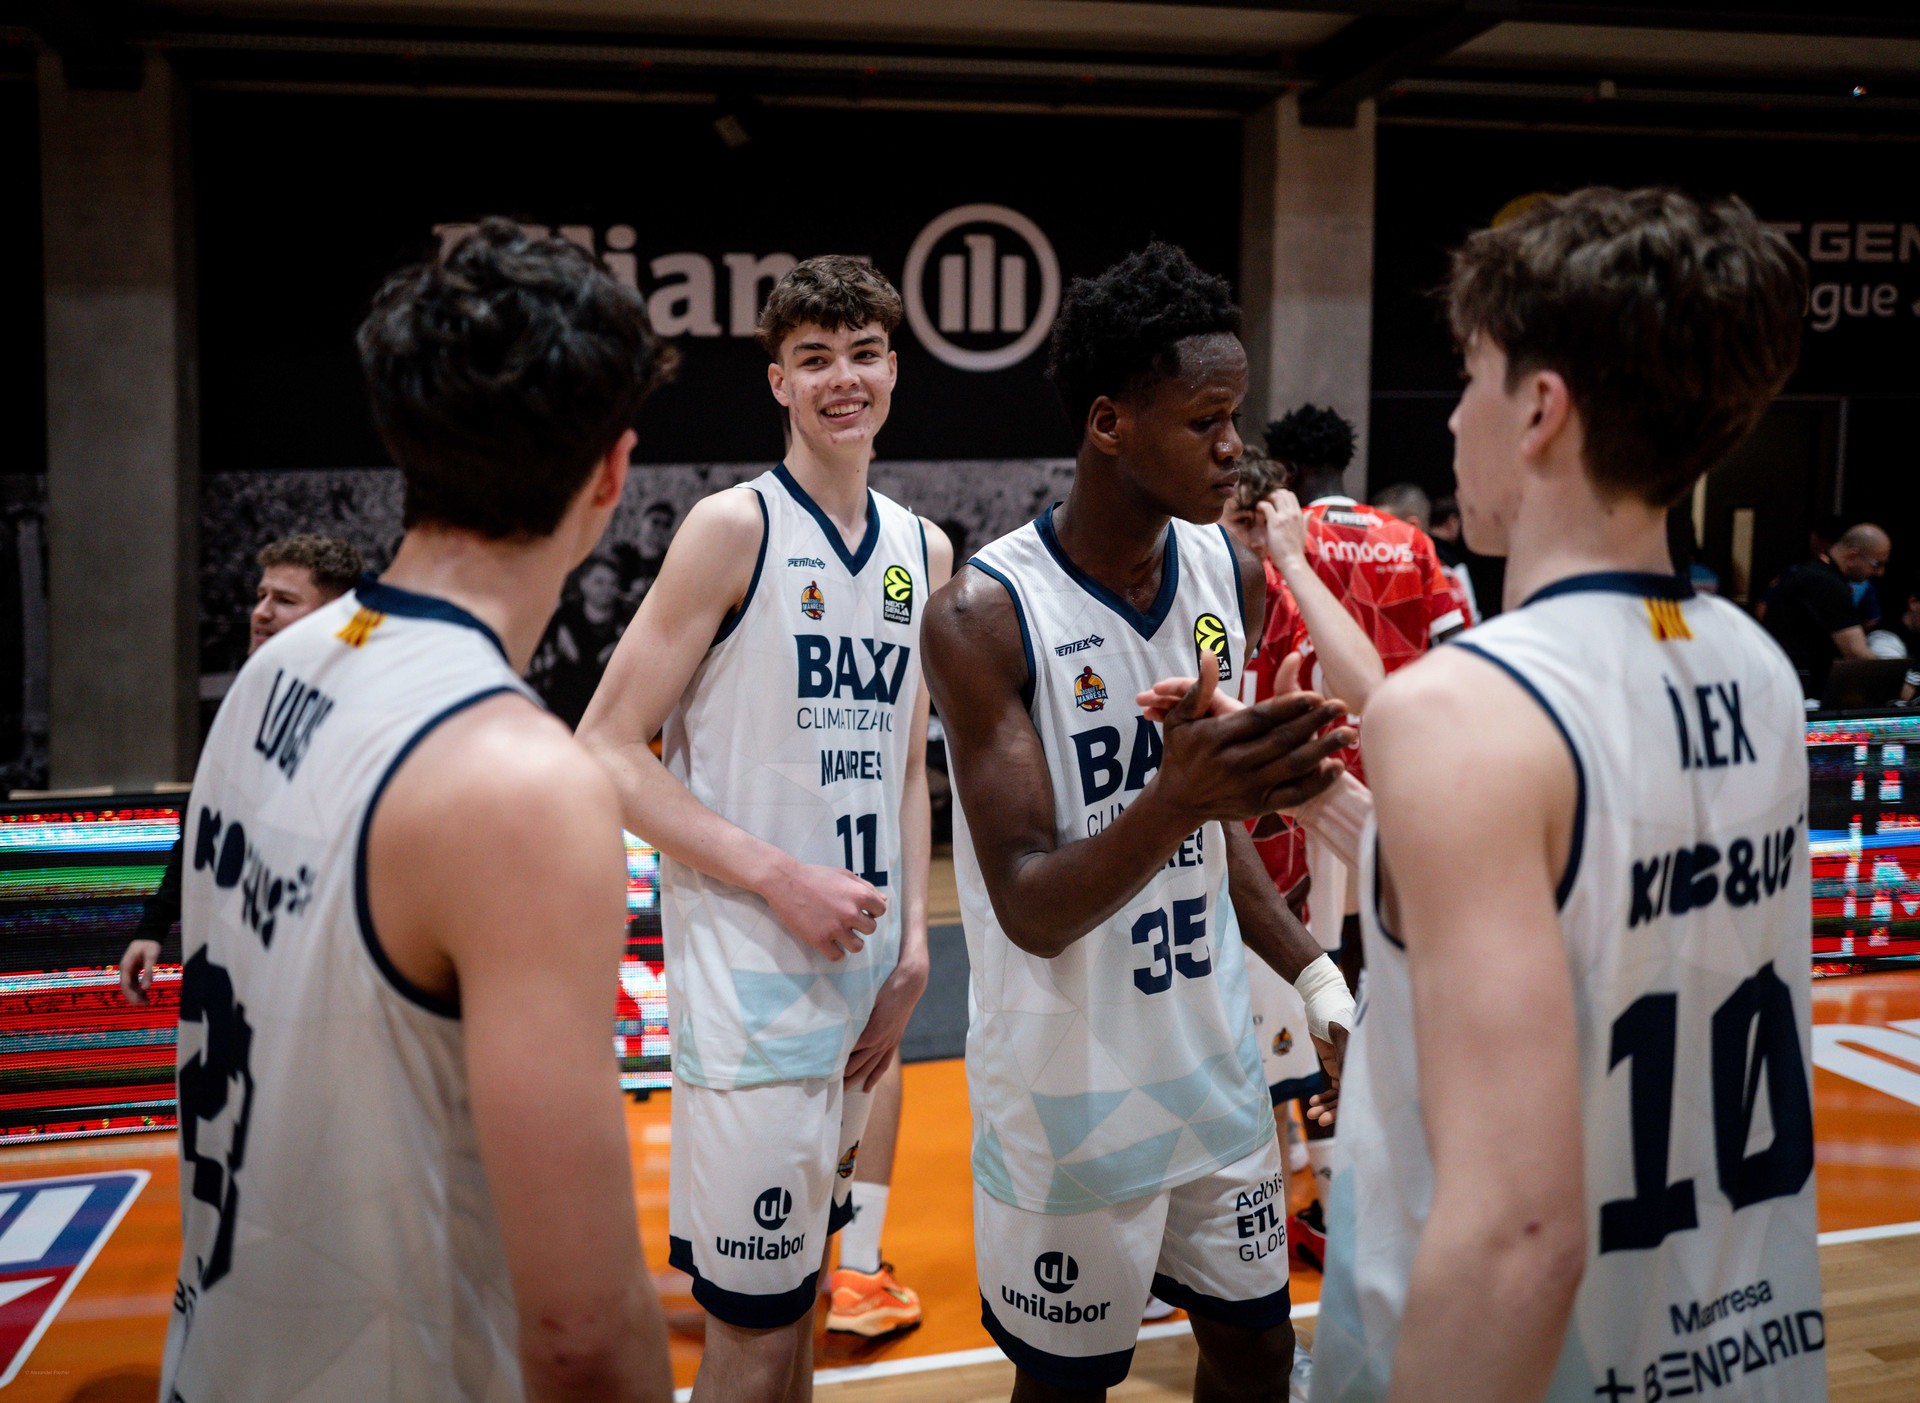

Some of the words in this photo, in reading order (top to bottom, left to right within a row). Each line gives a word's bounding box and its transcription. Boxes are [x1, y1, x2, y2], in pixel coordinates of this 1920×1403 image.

[793, 634, 911, 705] BAXI
[836, 813, 888, 887] 11
[1131, 892, 1212, 995] 35
[1600, 960, 1815, 1255] 10
[716, 1232, 805, 1261] unilabor
[1237, 1203, 1279, 1239] ETL
[1001, 1284, 1111, 1324] unilabor
[1670, 1280, 1773, 1336] Manresa
